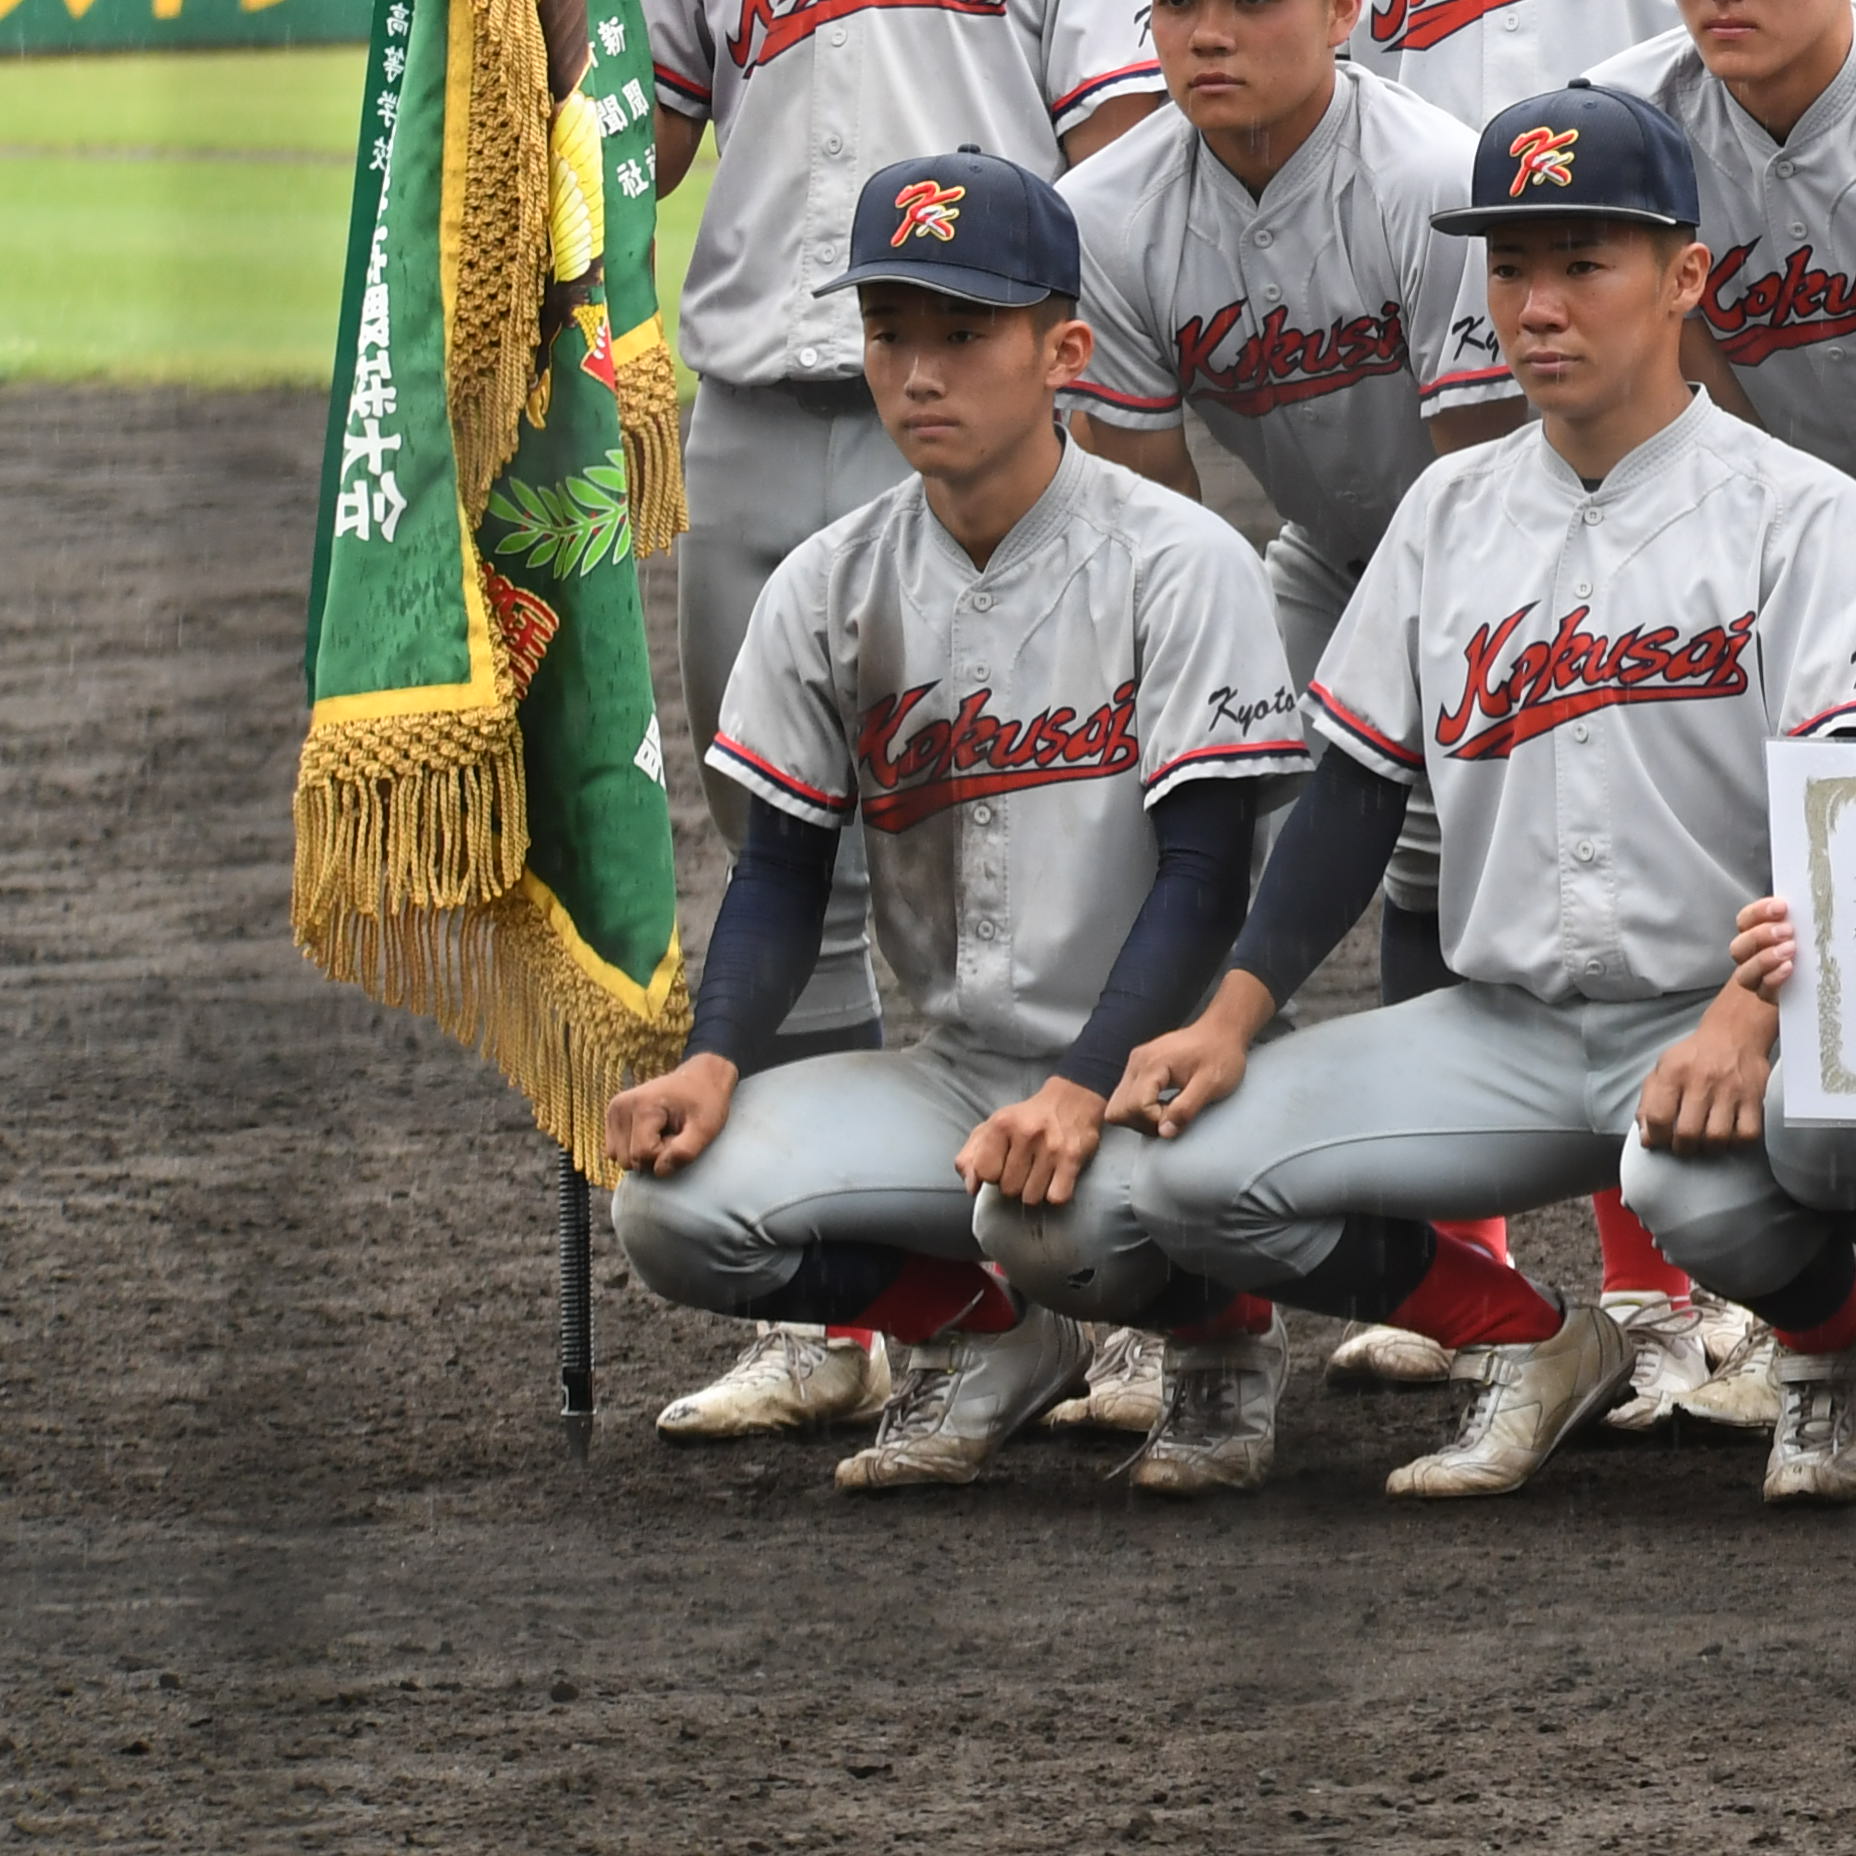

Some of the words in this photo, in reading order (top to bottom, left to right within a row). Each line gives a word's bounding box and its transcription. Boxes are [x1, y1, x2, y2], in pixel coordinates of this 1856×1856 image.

[858, 678, 1141, 834] Kokusai
[1207, 685, 1298, 738] Kyoto
[1435, 600, 1757, 759] Kokusai
